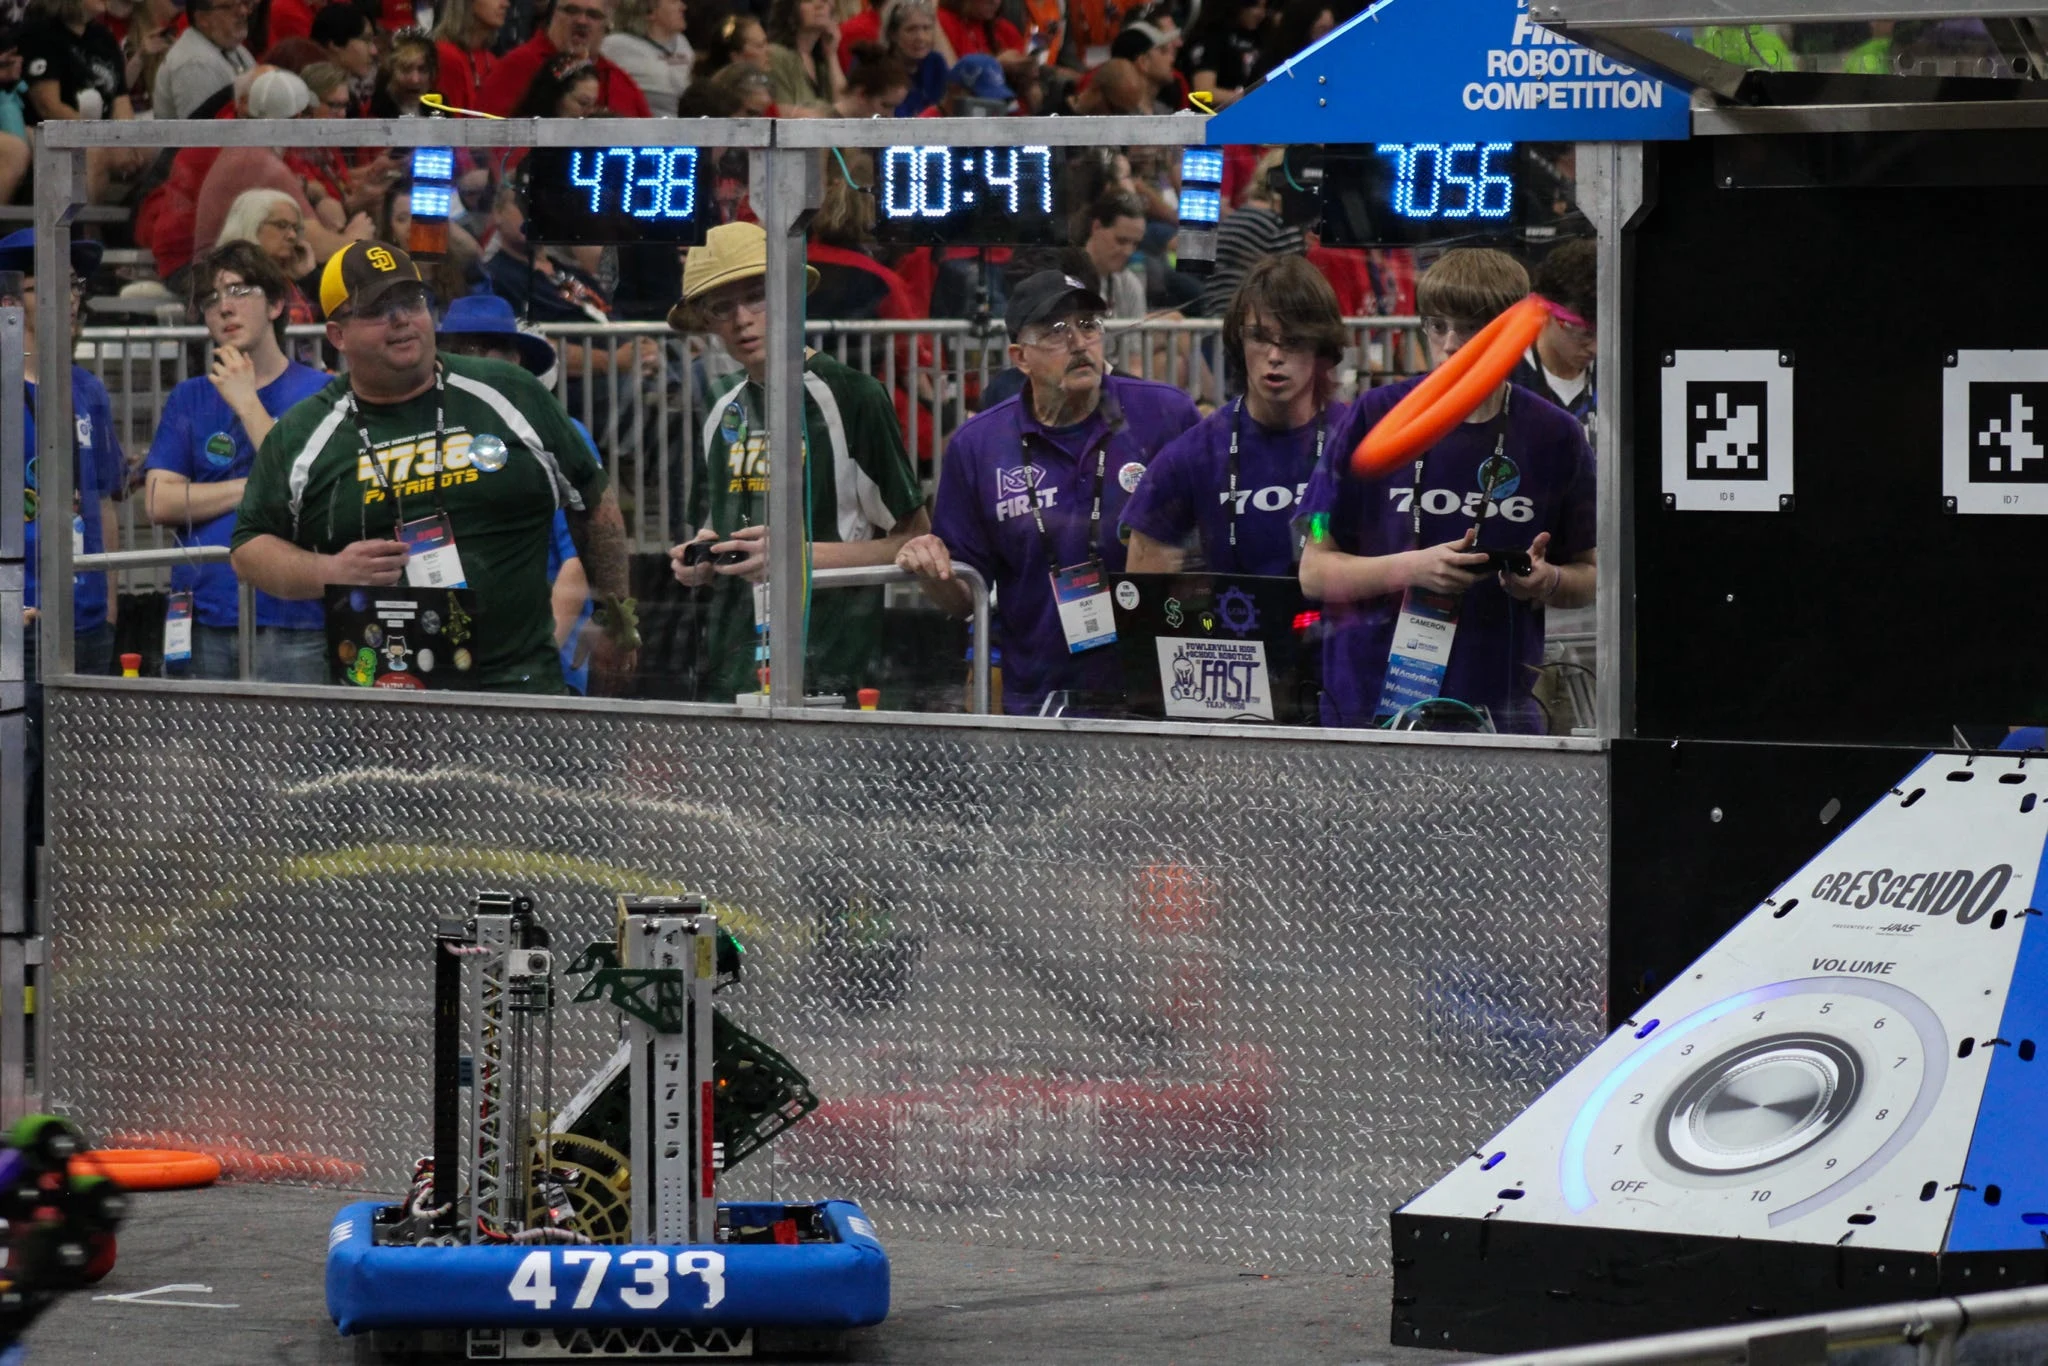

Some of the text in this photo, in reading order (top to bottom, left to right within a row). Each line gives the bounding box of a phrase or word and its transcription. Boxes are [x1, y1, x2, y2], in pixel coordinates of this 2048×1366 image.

[1462, 80, 1663, 111] COMPETITION
[571, 146, 698, 218] 4738
[885, 145, 1053, 217] 00:47
[1377, 142, 1513, 217] 7056
[357, 433, 475, 487] 4738
[1730, 492, 1735, 501] 8
[2003, 495, 2019, 504] ID 7
[1389, 487, 1535, 523] 7056
[1409, 617, 1447, 632] CAMERON
[1200, 659, 1261, 703] FAST
[1811, 863, 2013, 925] CRESCENDO
[1811, 957, 1897, 975] VOLUME
[1819, 1002, 1833, 1014] 5
[1752, 1010, 1766, 1023] 4
[1873, 1017, 1886, 1030] 6
[1681, 1044, 1694, 1056] 3
[1893, 1057, 1908, 1069] 7
[1629, 1093, 1644, 1105] 2
[1875, 1108, 1889, 1121] 8
[1612, 1144, 1623, 1155] 1
[1824, 1158, 1838, 1170] 9
[1610, 1180, 1648, 1193] OFF
[1750, 1190, 1772, 1203] 10
